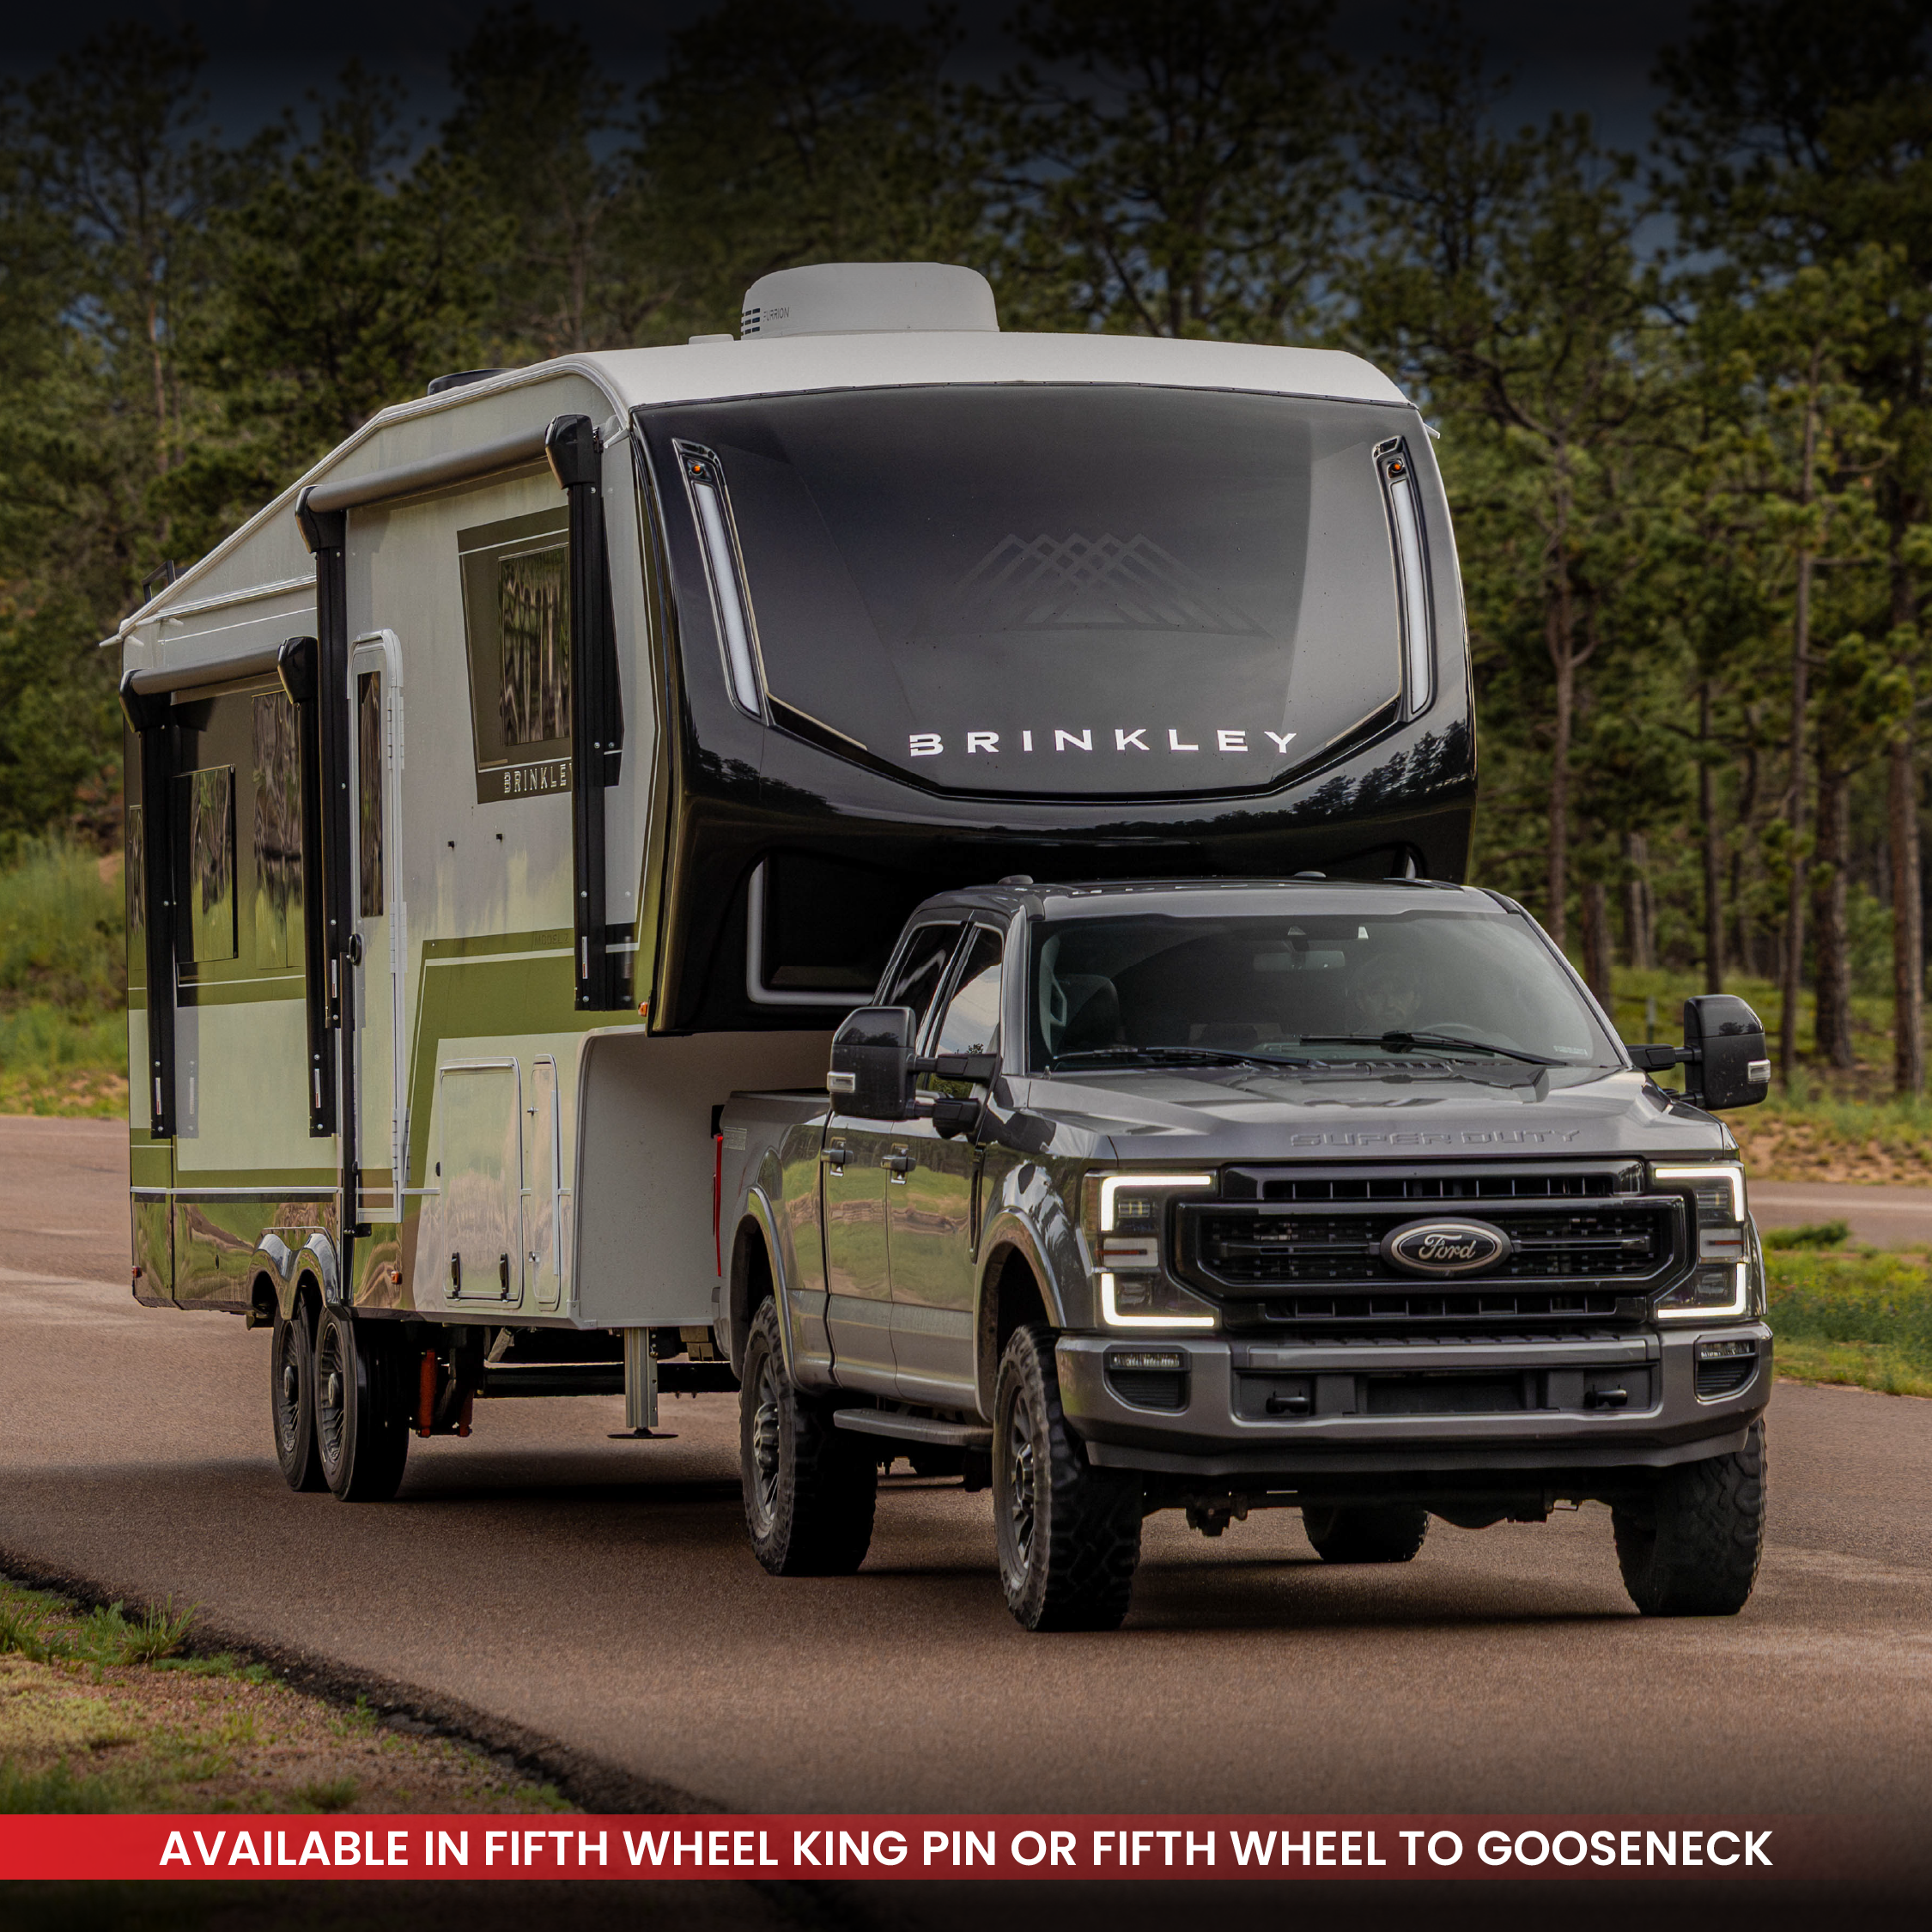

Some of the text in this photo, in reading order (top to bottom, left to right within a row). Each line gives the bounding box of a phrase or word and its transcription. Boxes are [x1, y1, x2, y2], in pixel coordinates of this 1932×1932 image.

[763, 307, 790, 322] FURRION
[908, 728, 1297, 757] BRINKLEY
[504, 762, 572, 793] BRINKLE
[534, 933, 562, 945] MODEL
[1291, 1130, 1580, 1147] SUPER DUTY
[1418, 1233, 1477, 1261] Ford
